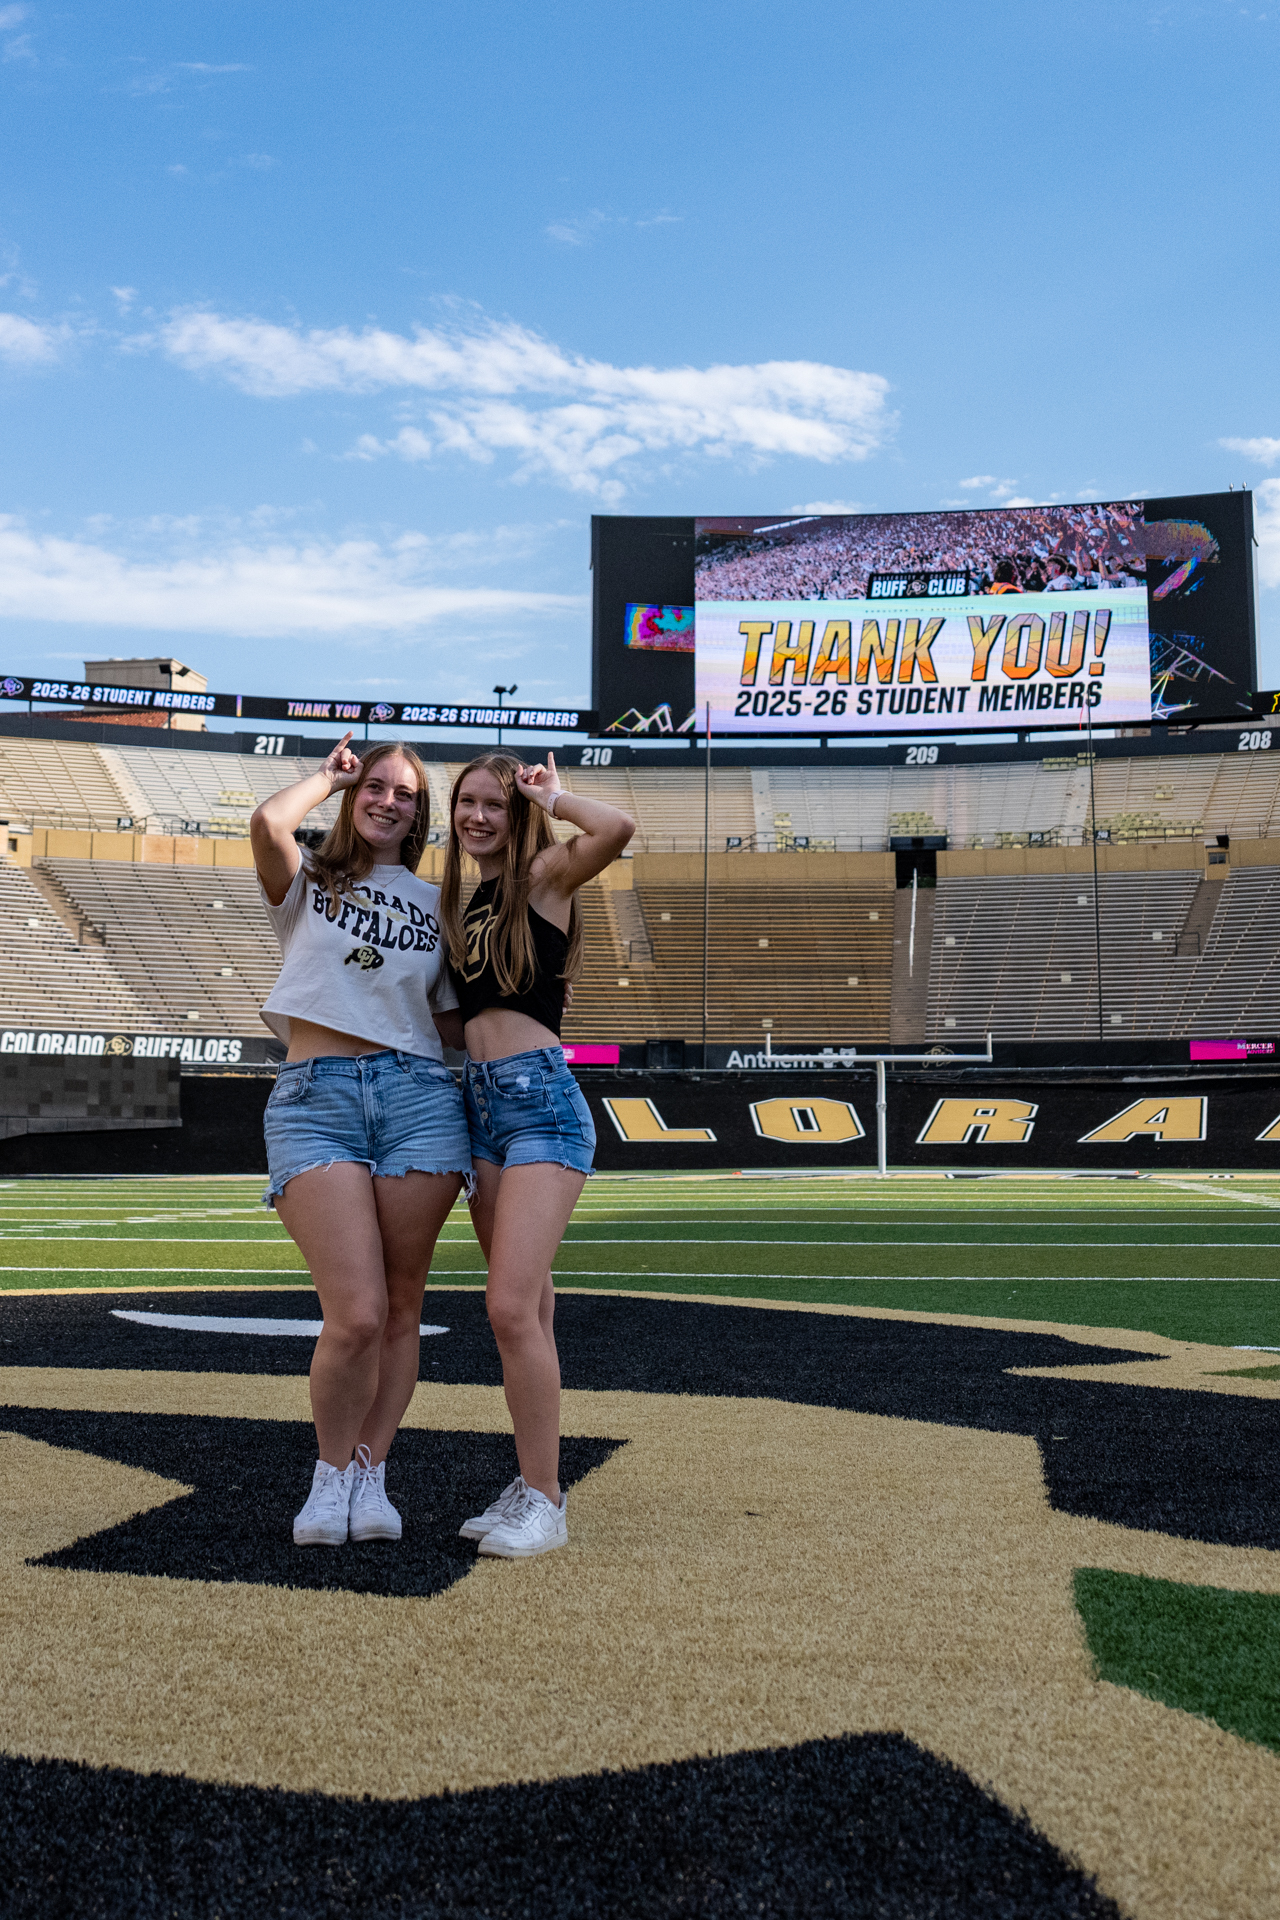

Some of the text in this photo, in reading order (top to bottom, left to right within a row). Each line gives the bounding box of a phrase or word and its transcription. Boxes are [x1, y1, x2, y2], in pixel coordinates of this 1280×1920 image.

[871, 580, 907, 598] BUFF
[927, 578, 966, 596] CLUB
[738, 609, 1112, 686] THANK YOU!
[31, 681, 91, 701] 2025-26
[92, 686, 152, 706] STUDENT
[153, 691, 216, 711] MEMBERS
[734, 681, 1103, 717] 2025-26 STUDENT MEMBERS
[287, 701, 332, 718] THANK
[334, 703, 361, 719] YOU
[401, 706, 457, 722] 2025-26
[459, 708, 517, 725] STUDENT
[518, 710, 578, 727] MEMBERS
[254, 735, 285, 755] 211
[1238, 730, 1272, 751] 208
[580, 747, 612, 766] 210
[905, 746, 939, 764] 209
[313, 889, 438, 953] BUFFALOES
[1, 1031, 105, 1056] COLORADO
[132, 1036, 243, 1063] BUFFALOES
